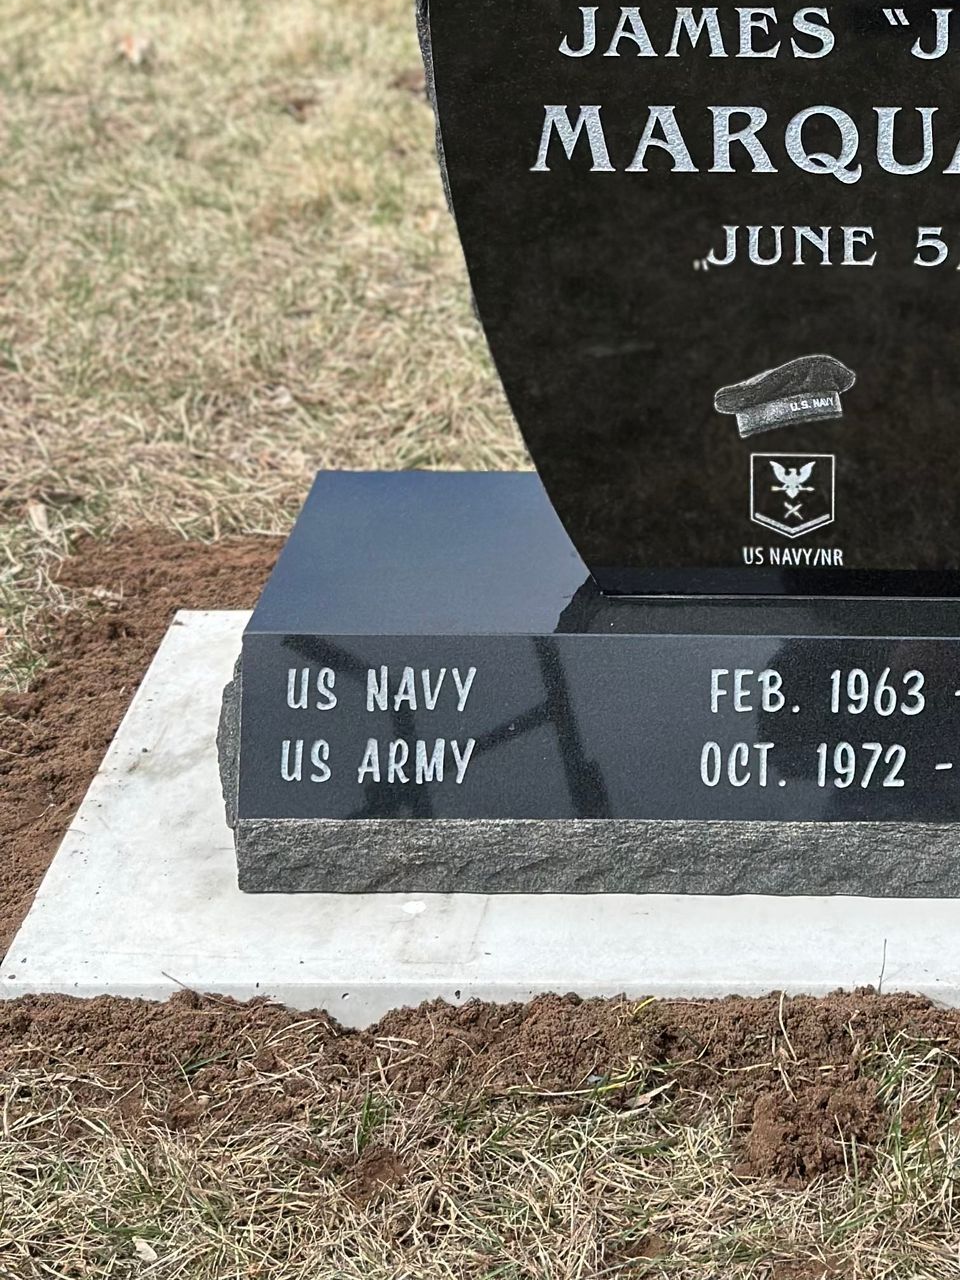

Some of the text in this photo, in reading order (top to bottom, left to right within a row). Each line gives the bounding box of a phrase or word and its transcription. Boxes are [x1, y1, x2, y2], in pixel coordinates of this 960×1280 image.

[558, 6, 835, 60] JAMES
[705, 225, 877, 267] JUNE
[790, 397, 834, 412] U.S. NAVY
[742, 546, 845, 568] US NAVY/NR
[286, 664, 477, 713] US NAVY
[710, 668, 802, 714] FEB.
[830, 666, 927, 717] 1963
[280, 737, 476, 786] US ARMY
[700, 740, 788, 788] OCT.
[815, 741, 907, 790] 1972
